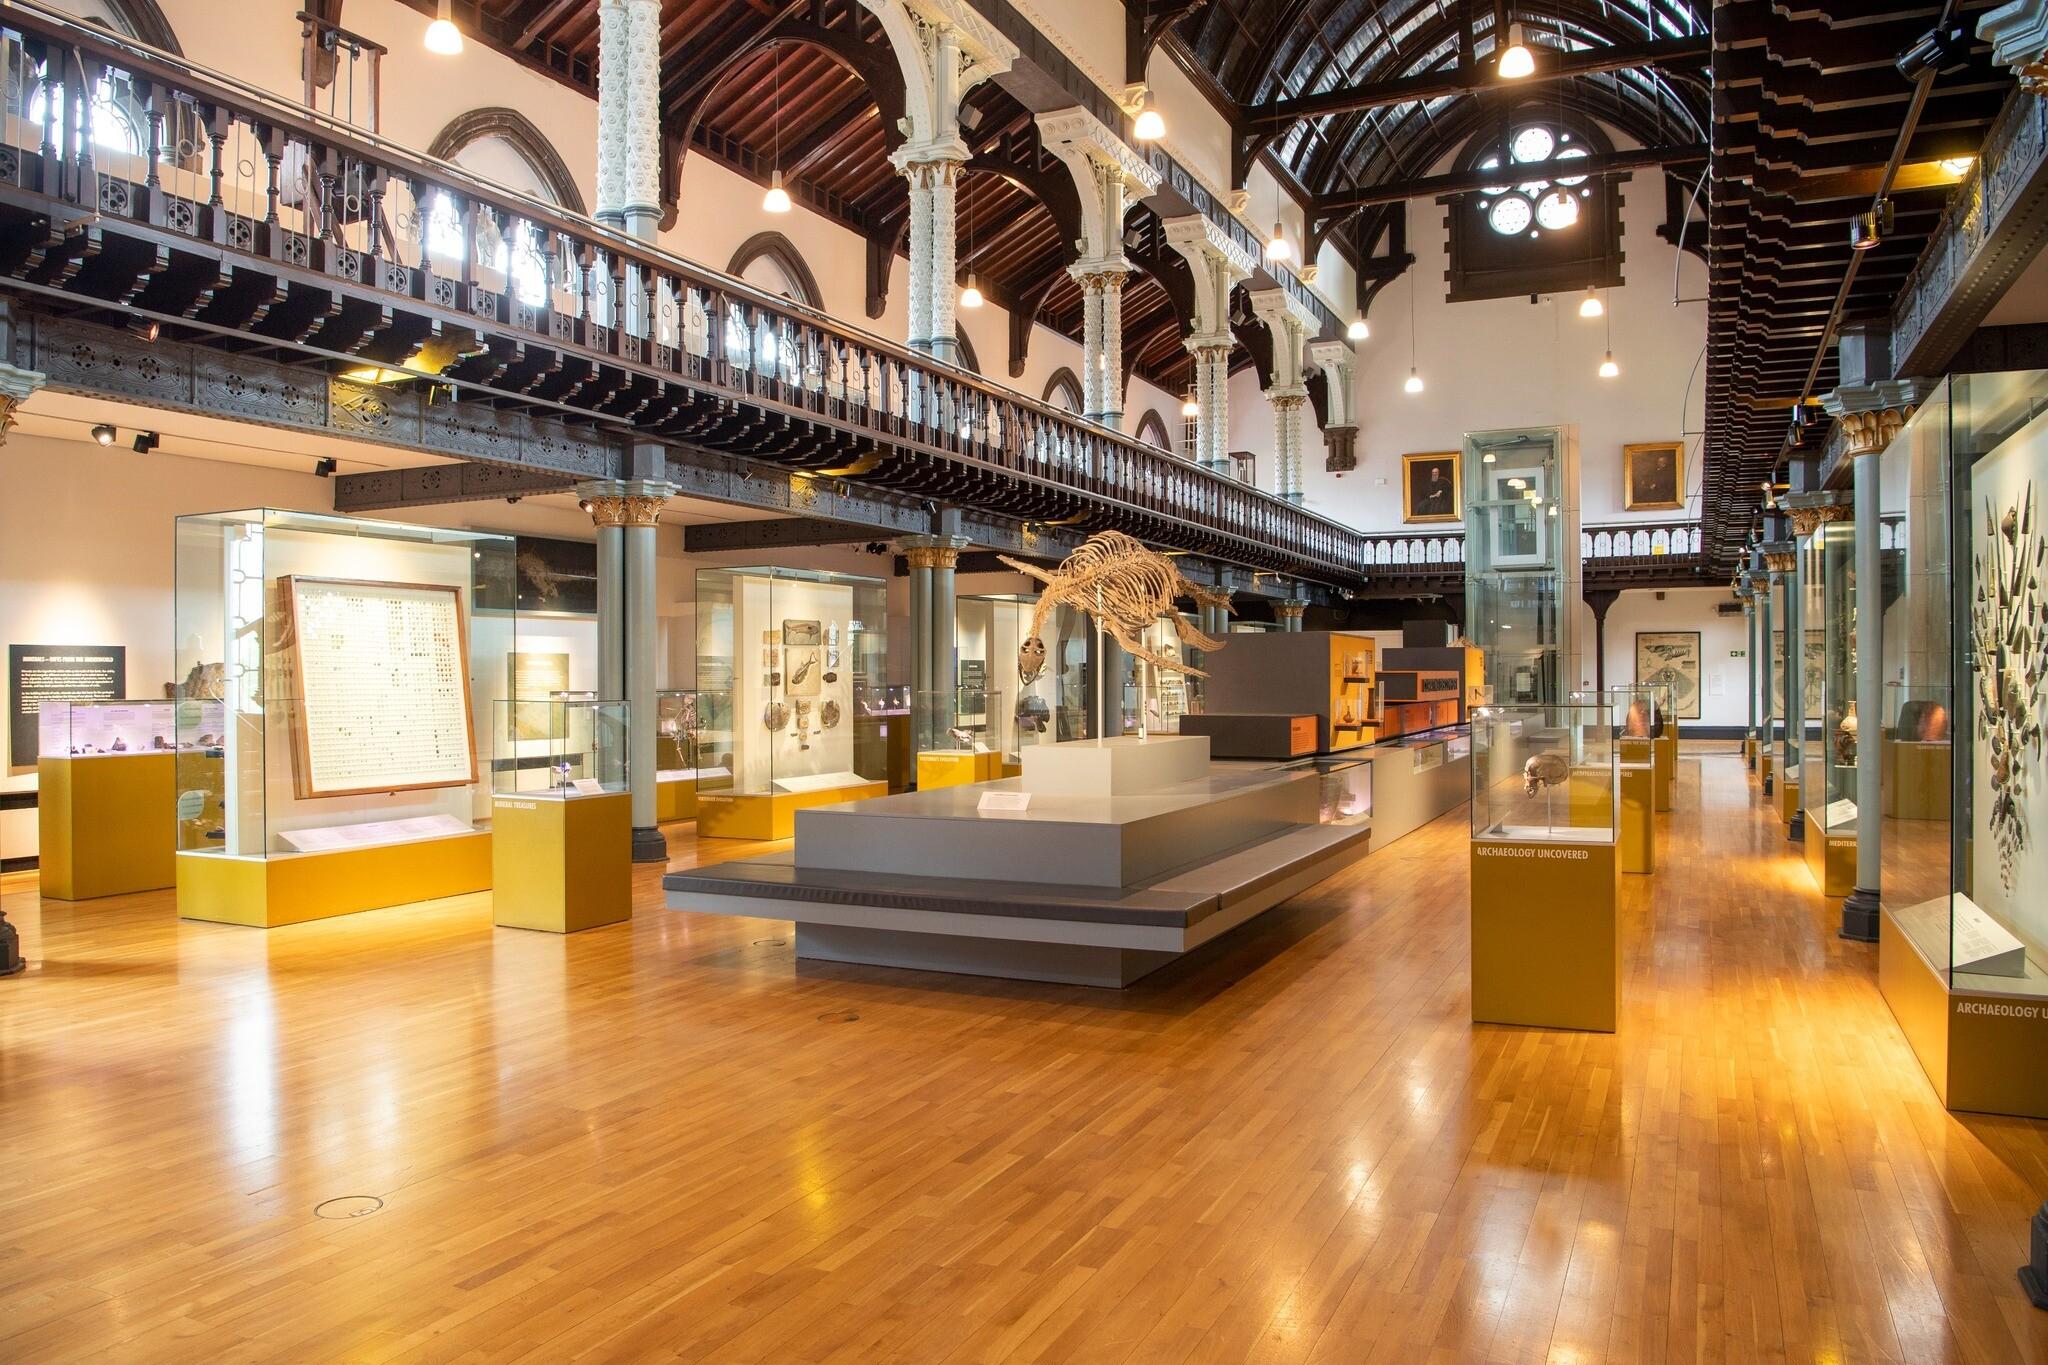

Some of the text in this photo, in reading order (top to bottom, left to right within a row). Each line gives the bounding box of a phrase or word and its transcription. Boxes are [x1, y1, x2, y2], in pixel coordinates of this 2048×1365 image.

[1477, 847, 1588, 860] ARCHAEOLOGY UNCOVERED
[1956, 1002, 2040, 1018] ARCHAEOLOGY
